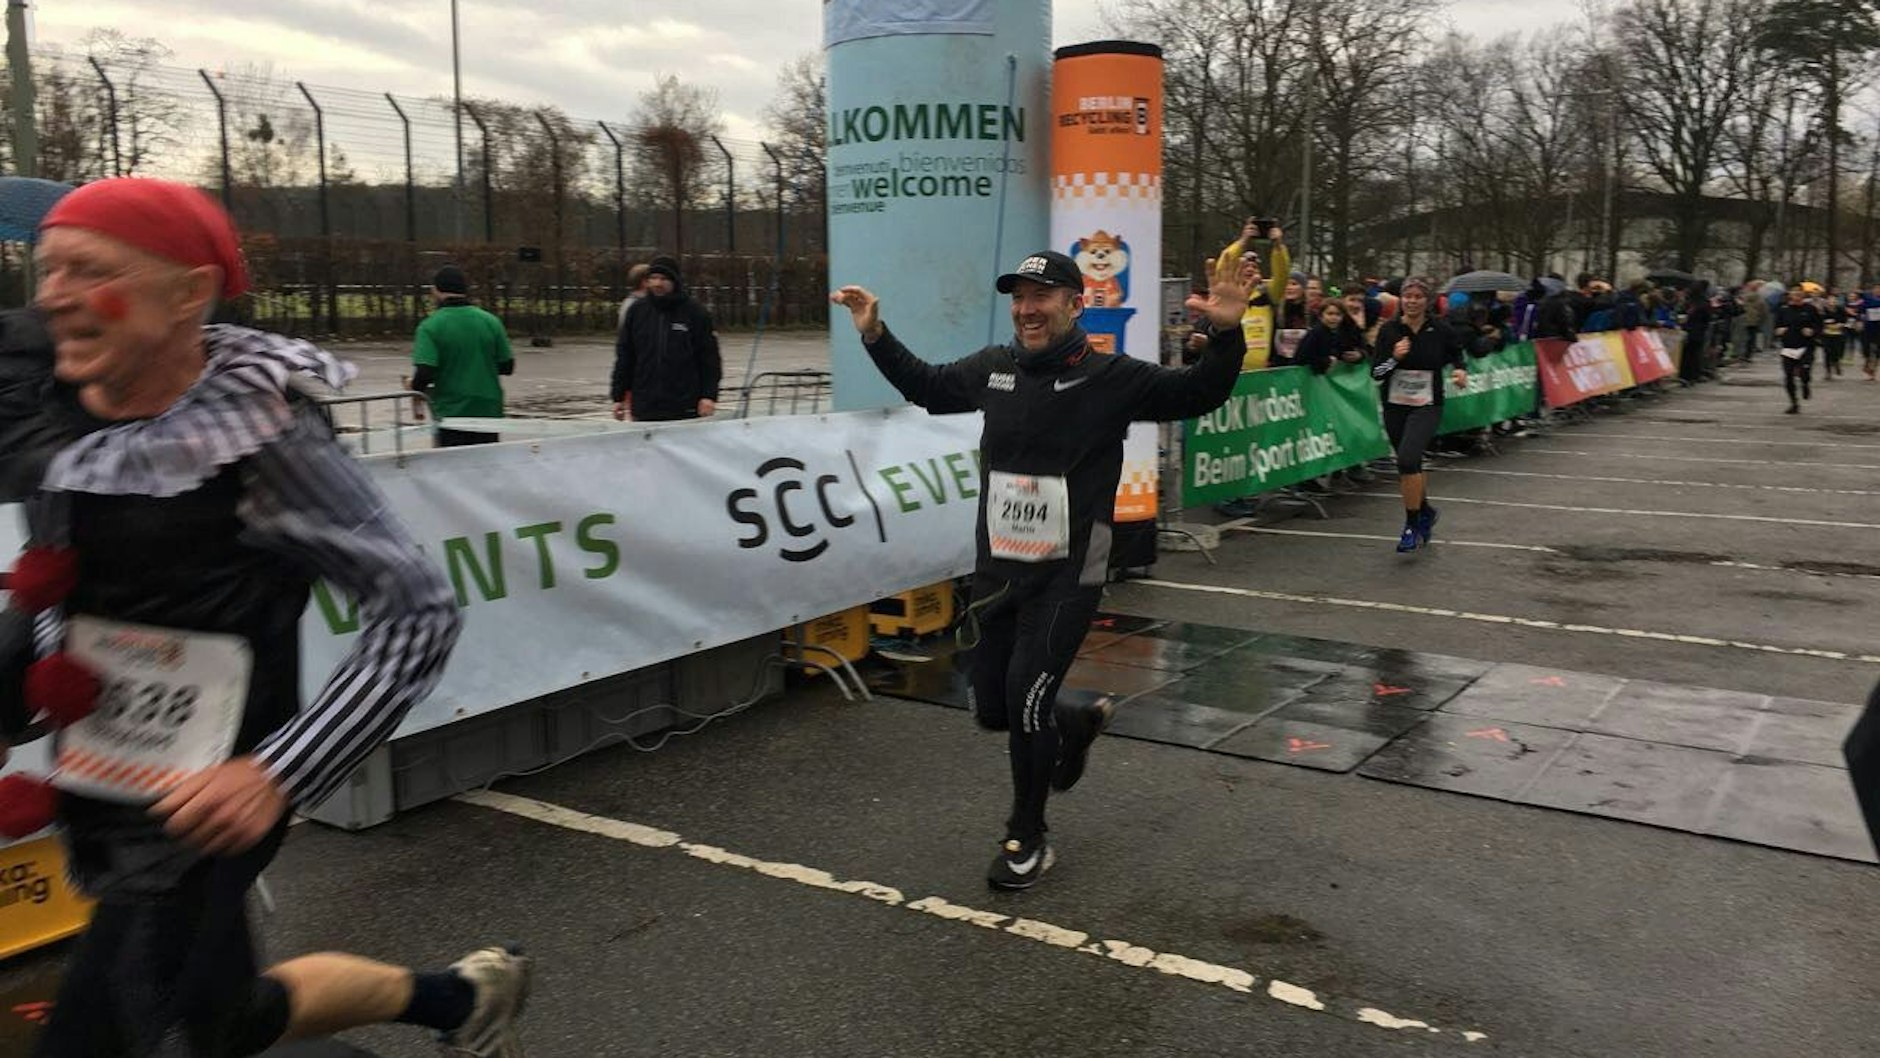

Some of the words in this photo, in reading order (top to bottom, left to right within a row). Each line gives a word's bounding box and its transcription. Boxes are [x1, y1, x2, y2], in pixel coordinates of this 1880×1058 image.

[829, 103, 1025, 147] LKOMMEN
[852, 167, 992, 199] welcome
[1195, 394, 1244, 435] AOK
[878, 449, 981, 513] EVE
[1194, 446, 1247, 488] Beim
[309, 512, 620, 635] VNTS
